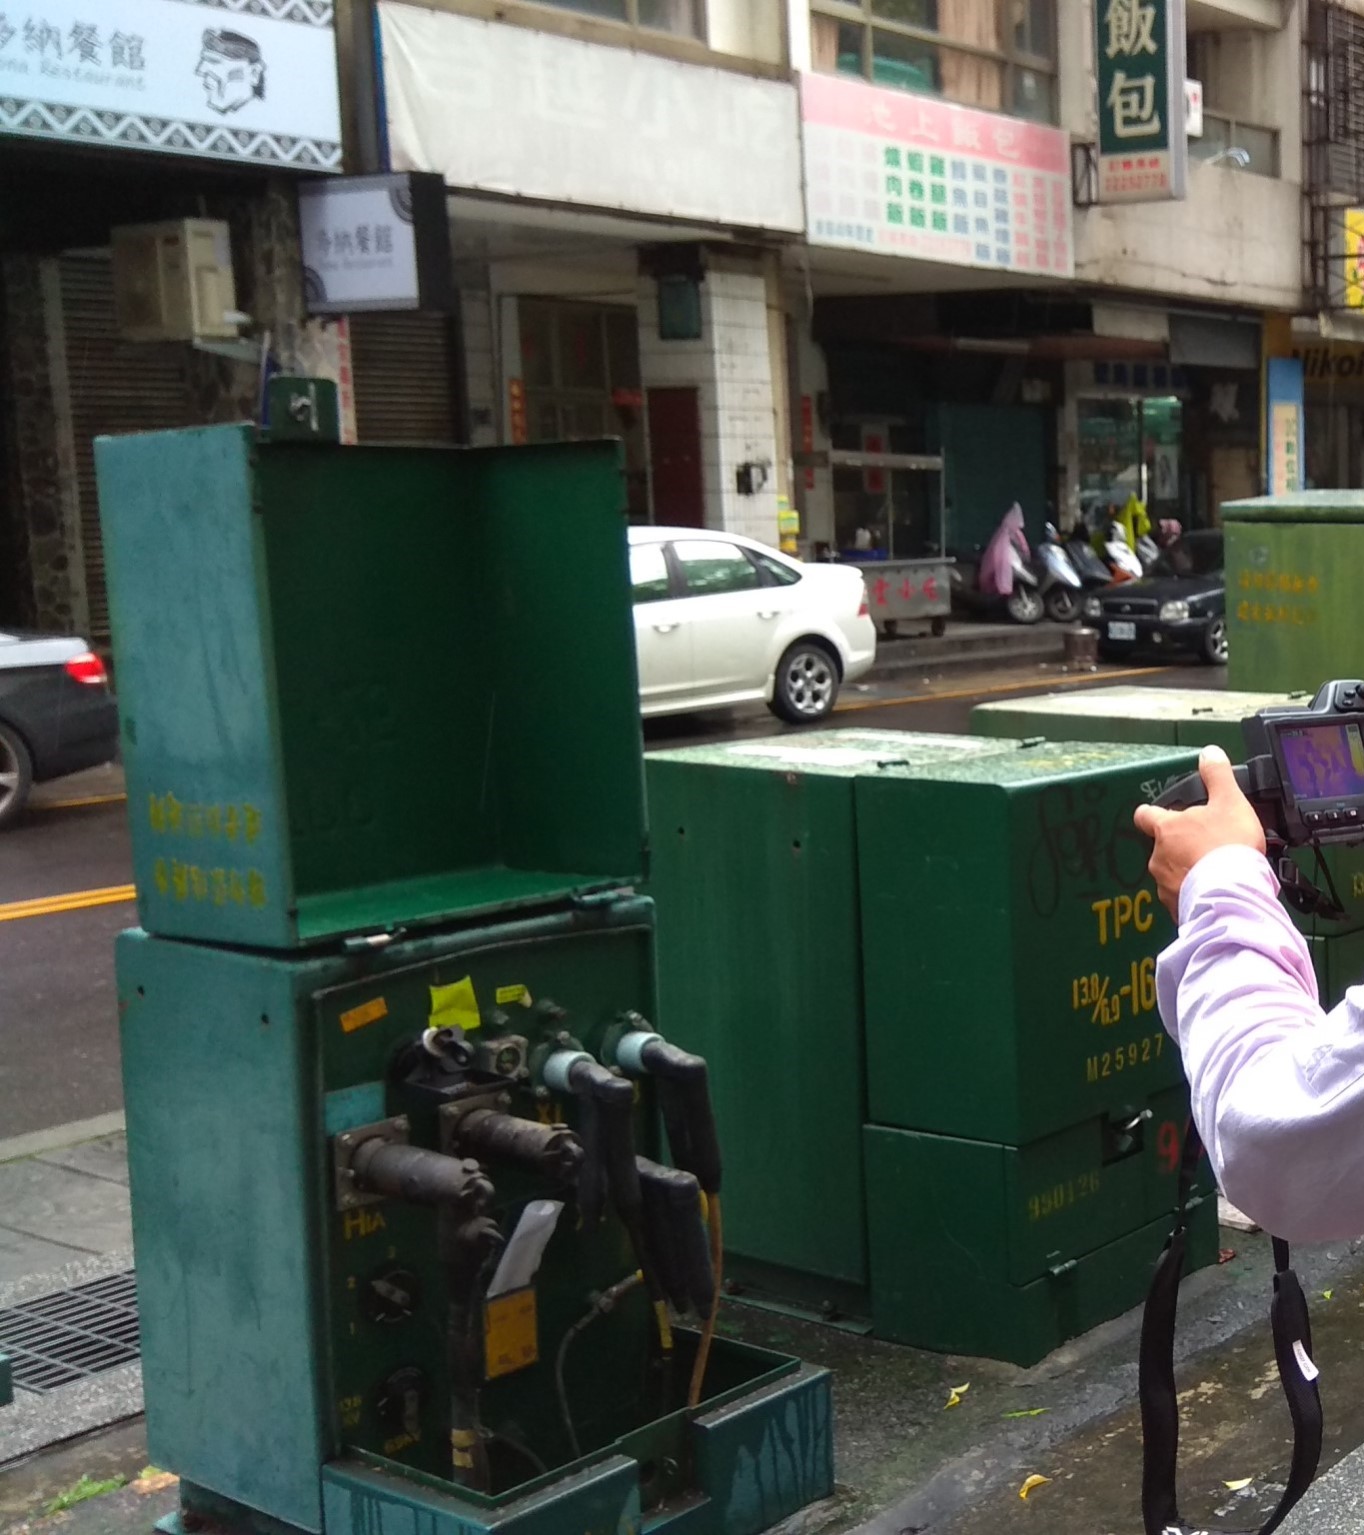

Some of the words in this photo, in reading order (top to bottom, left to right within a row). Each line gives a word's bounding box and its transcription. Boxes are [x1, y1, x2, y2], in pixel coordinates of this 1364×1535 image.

[1104, 0, 1162, 138] 飯包
[1092, 889, 1153, 945] TPC
[1086, 1032, 1163, 1082] M25927
